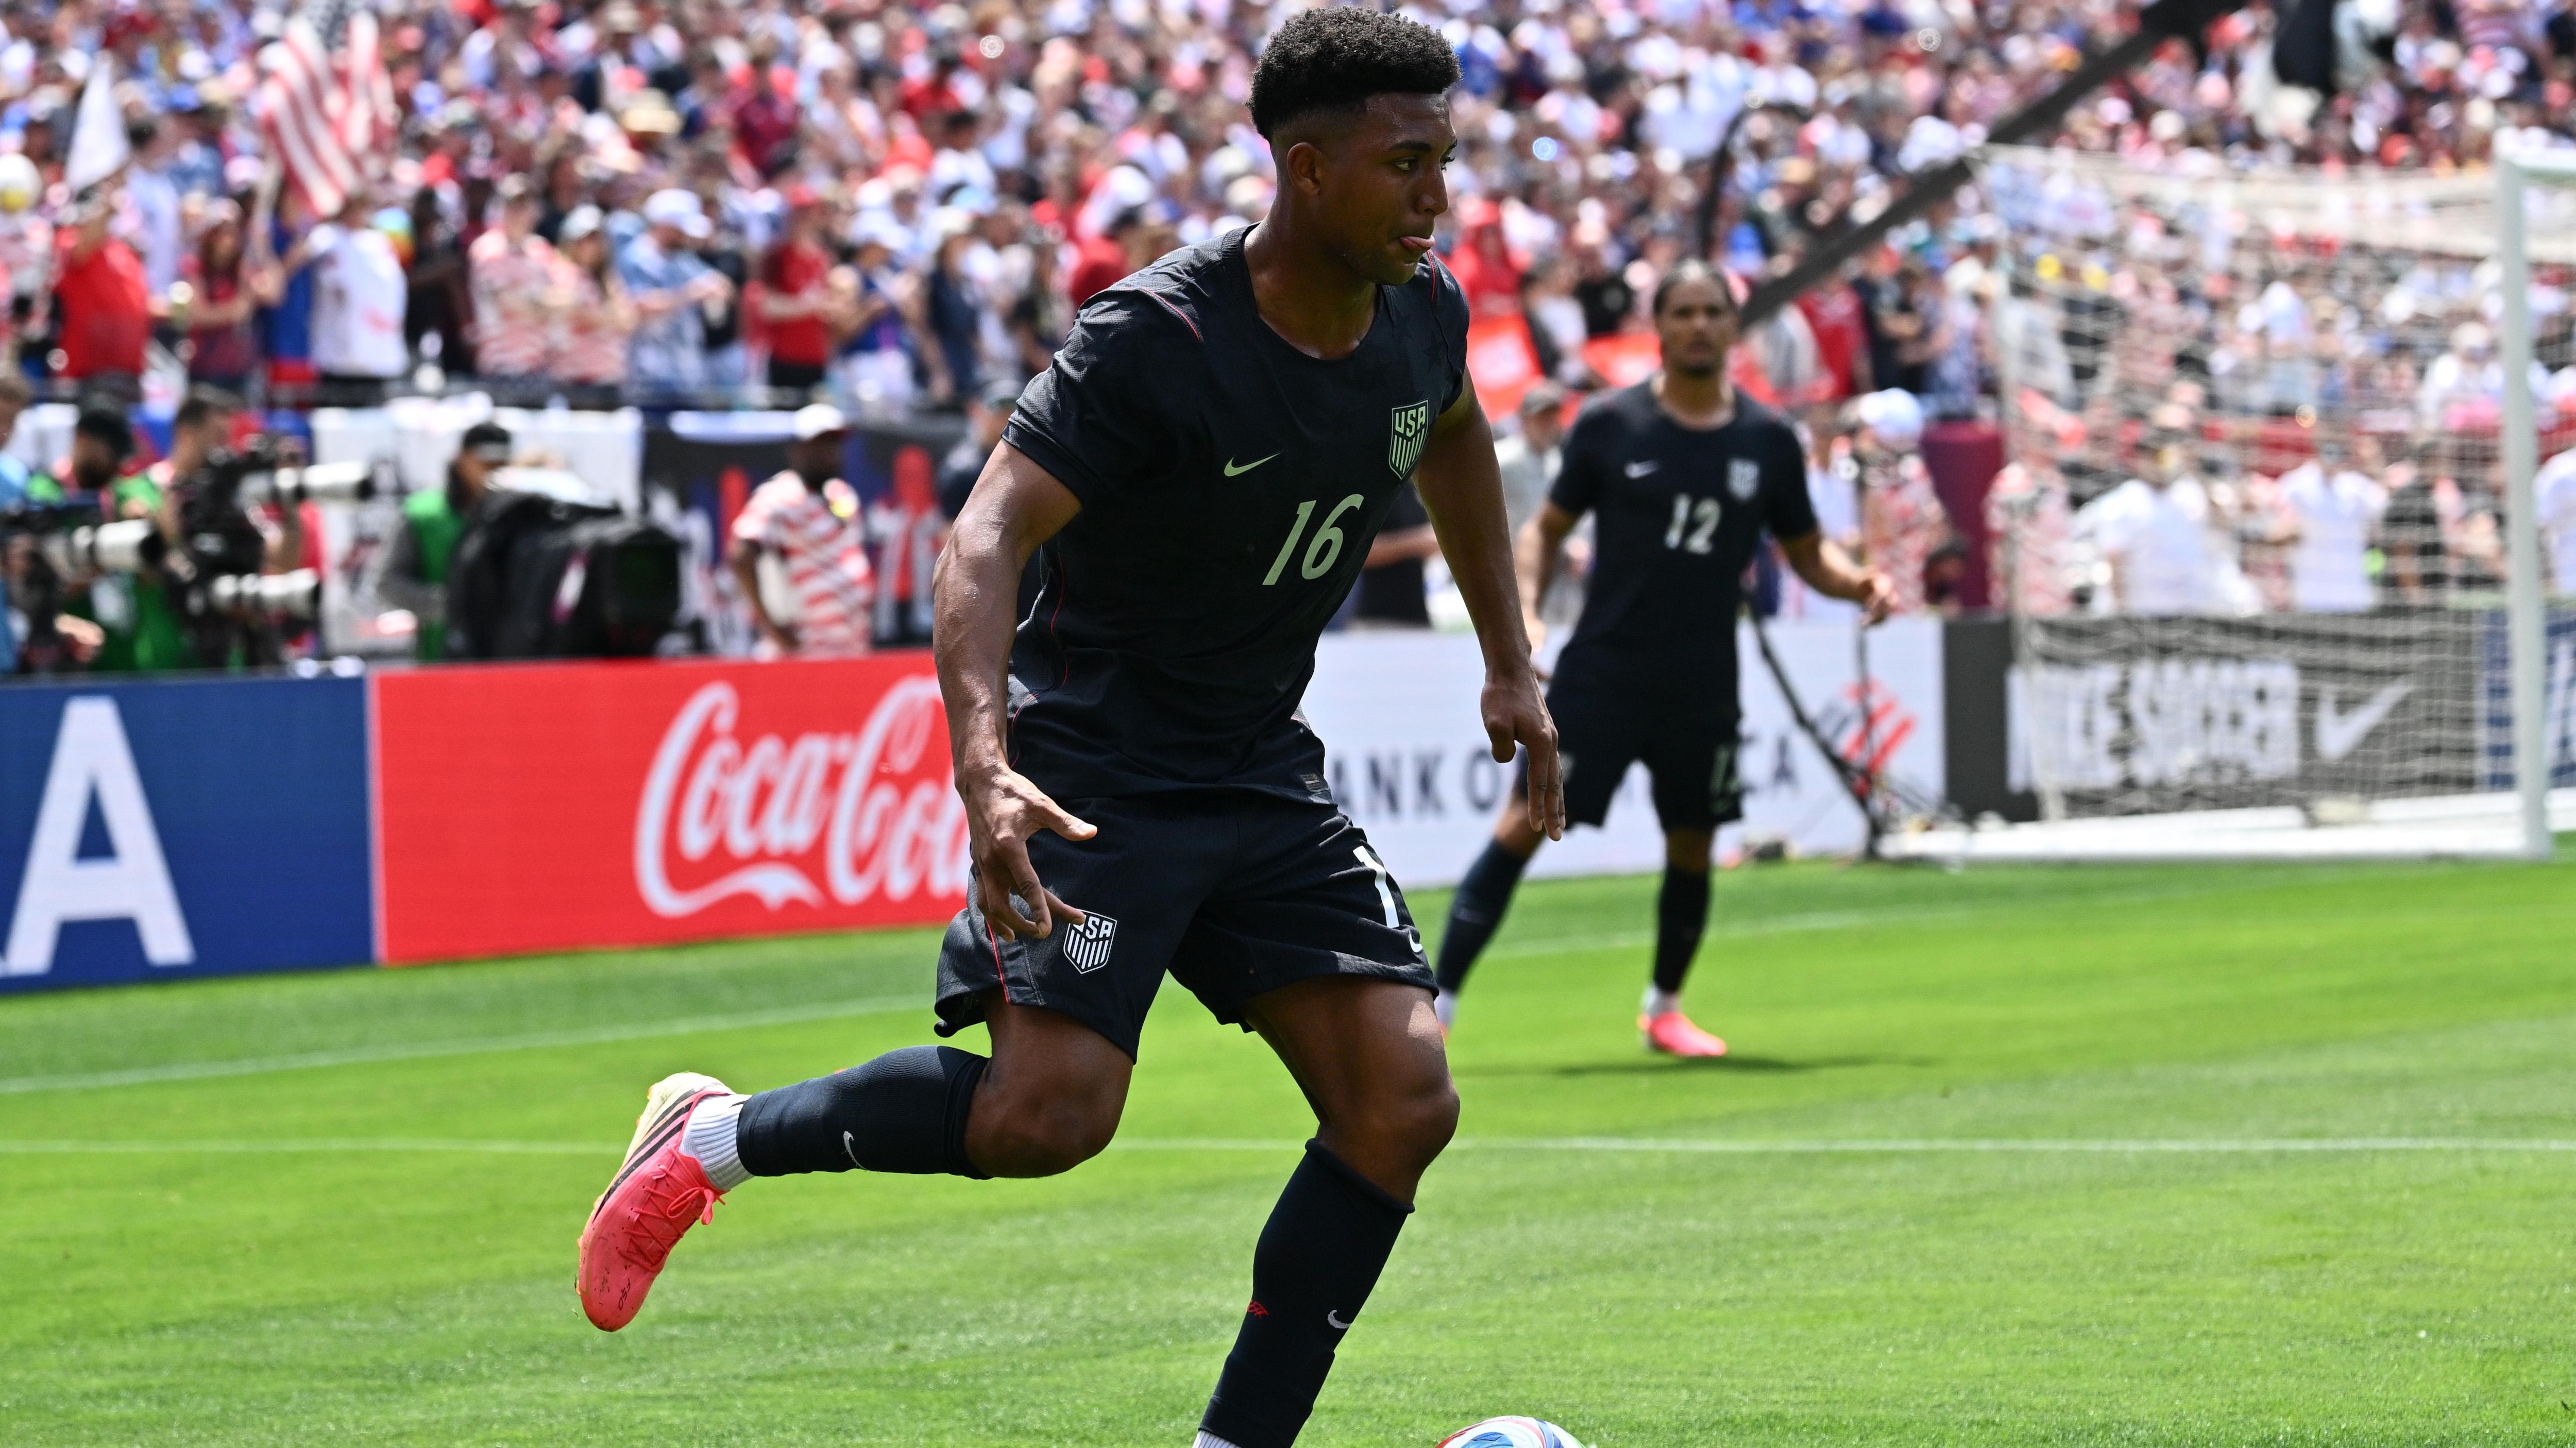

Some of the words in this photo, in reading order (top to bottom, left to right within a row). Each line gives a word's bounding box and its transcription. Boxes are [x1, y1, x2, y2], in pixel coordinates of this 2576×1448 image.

[1395, 406, 1426, 437] USA
[1262, 493, 1364, 585] 16
[1665, 493, 1722, 554] 12
[634, 676, 973, 919] Coca-Col
[1330, 746, 1447, 818] ANK
[1461, 746, 1505, 814] O
[0, 695, 197, 977] A
[618, 1278, 631, 1311] F50
